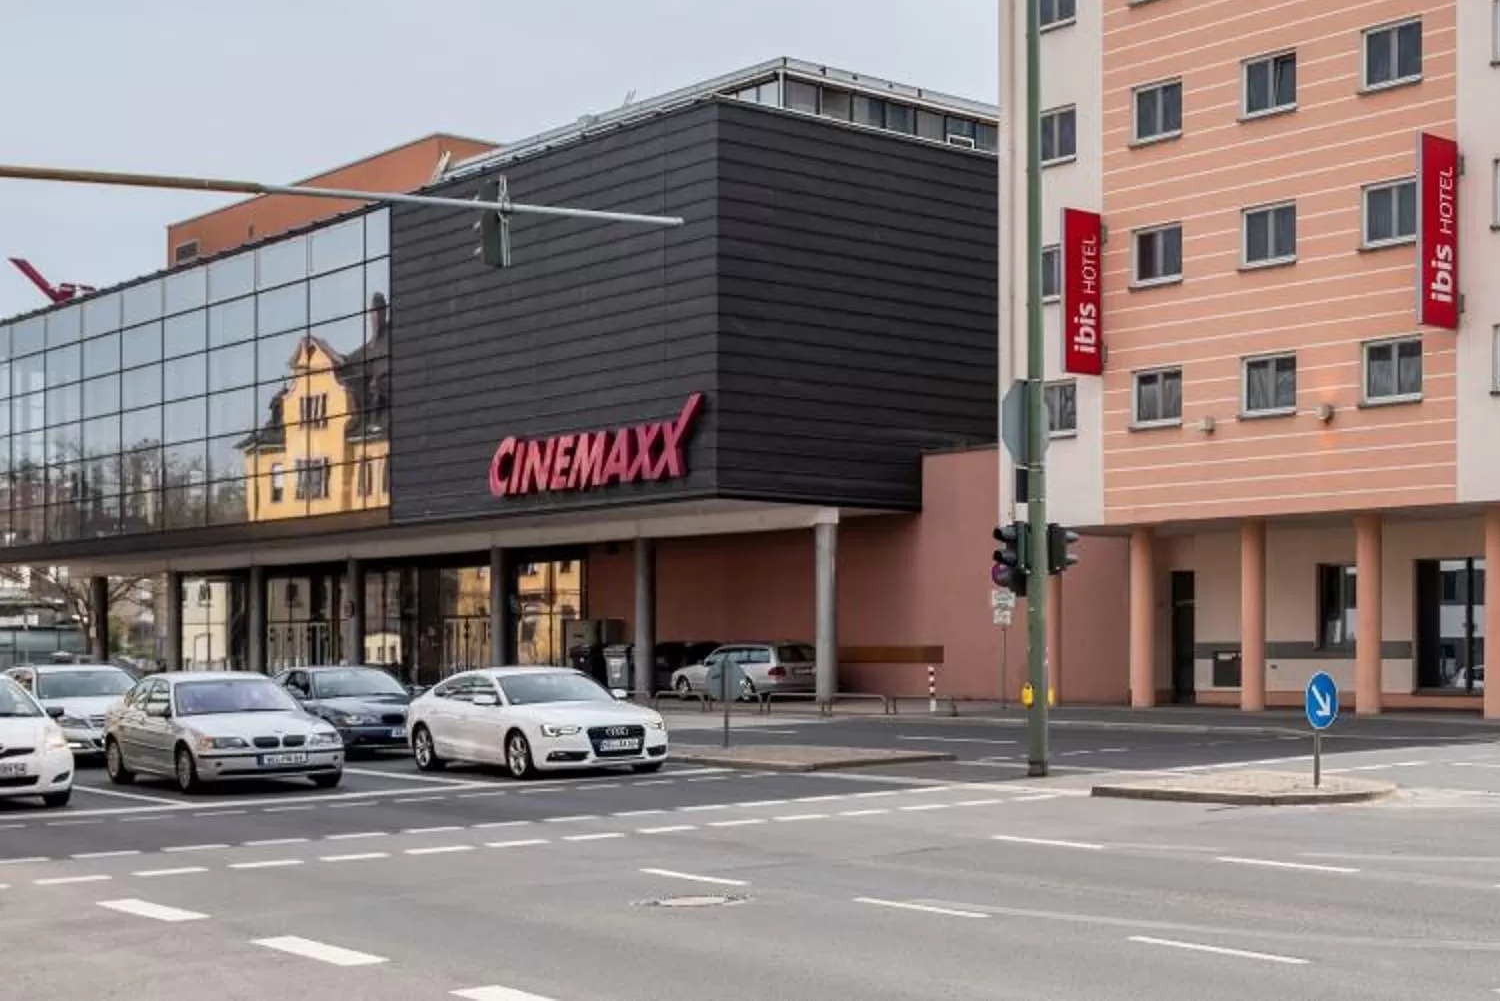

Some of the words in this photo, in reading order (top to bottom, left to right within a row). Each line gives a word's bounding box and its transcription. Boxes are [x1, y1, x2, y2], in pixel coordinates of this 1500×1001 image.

[1439, 165, 1454, 236] HOTEL
[1081, 233, 1098, 296] HOTEL
[1430, 243, 1454, 304] ibis
[1073, 301, 1098, 355] ibis
[488, 389, 706, 498] CINEMAXX
